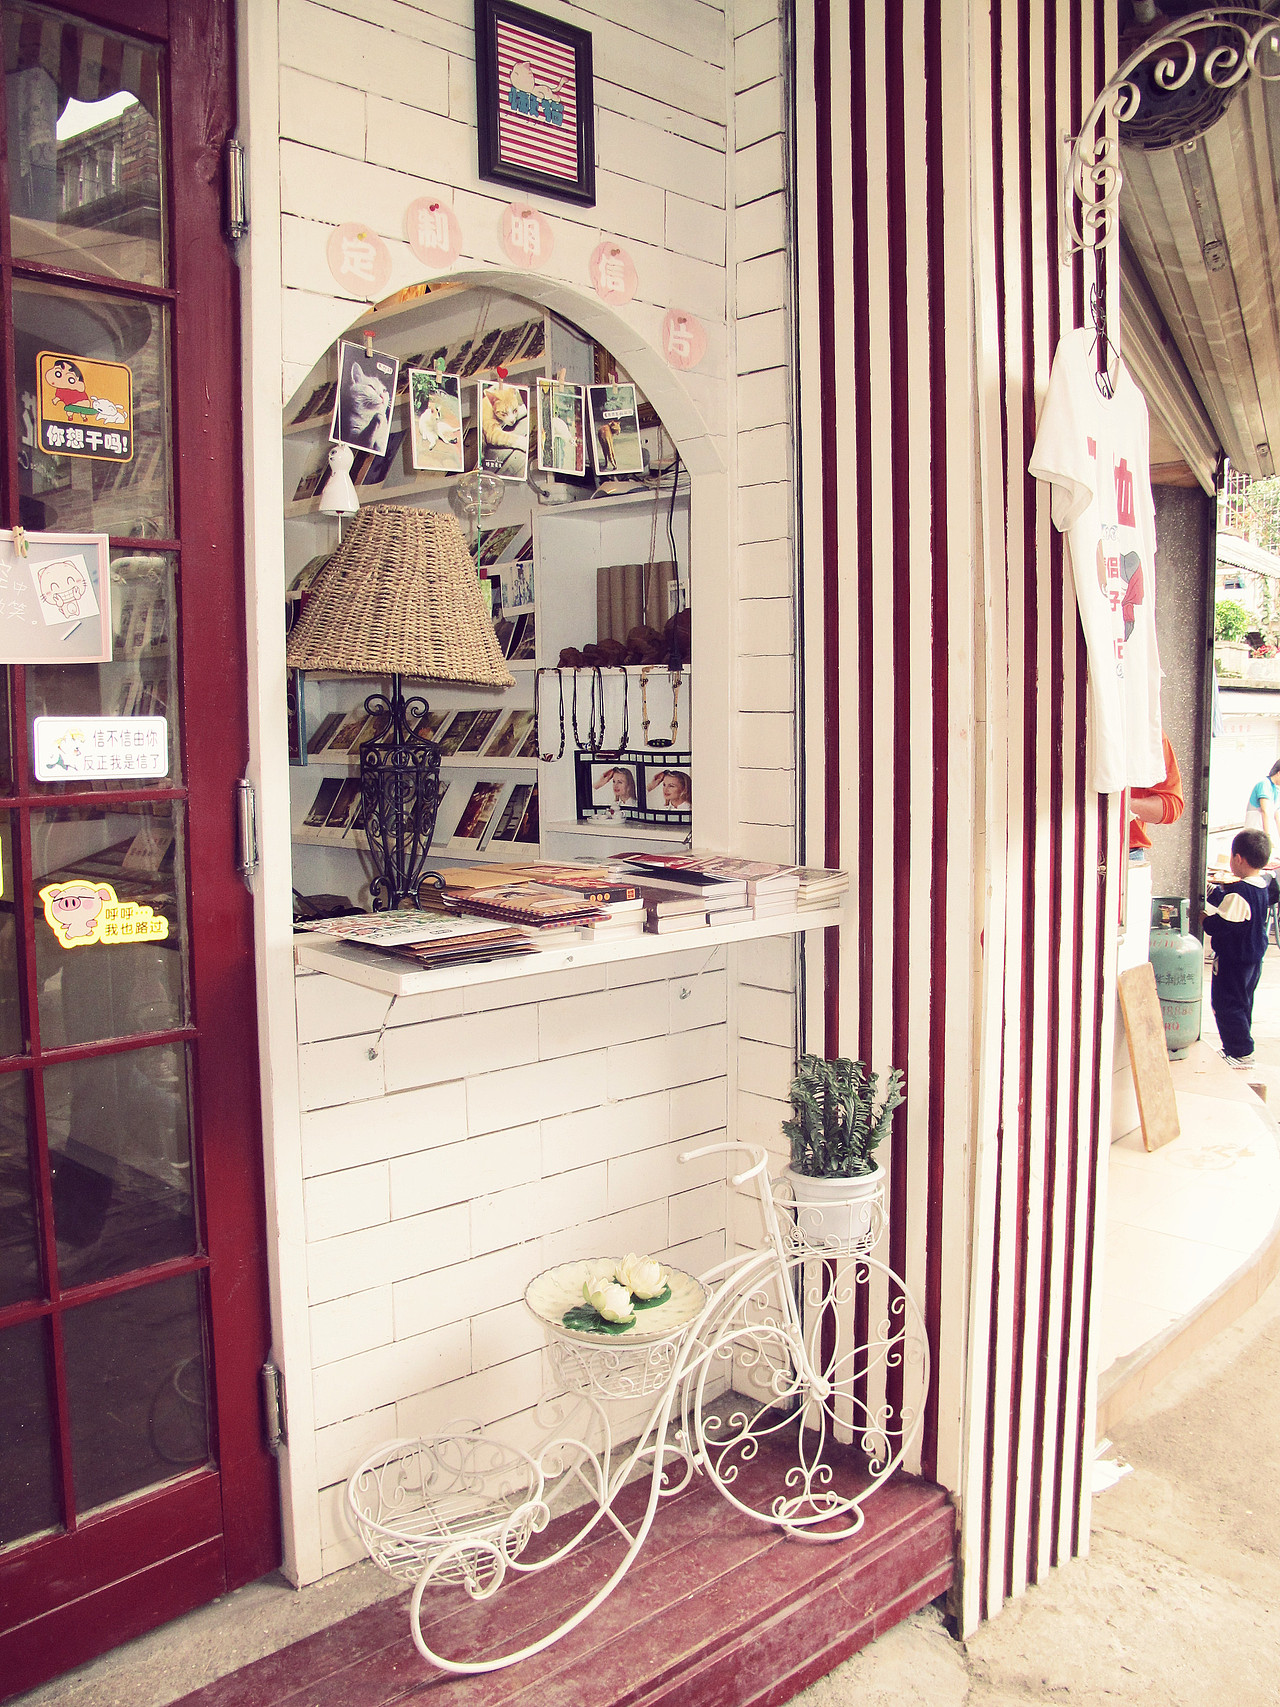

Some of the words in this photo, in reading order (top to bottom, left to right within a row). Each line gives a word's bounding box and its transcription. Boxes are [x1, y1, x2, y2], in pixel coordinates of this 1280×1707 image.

[93, 728, 159, 748] 信不信由你
[83, 753, 160, 772] 反正我是信了
[105, 922, 164, 937] 我也路过
